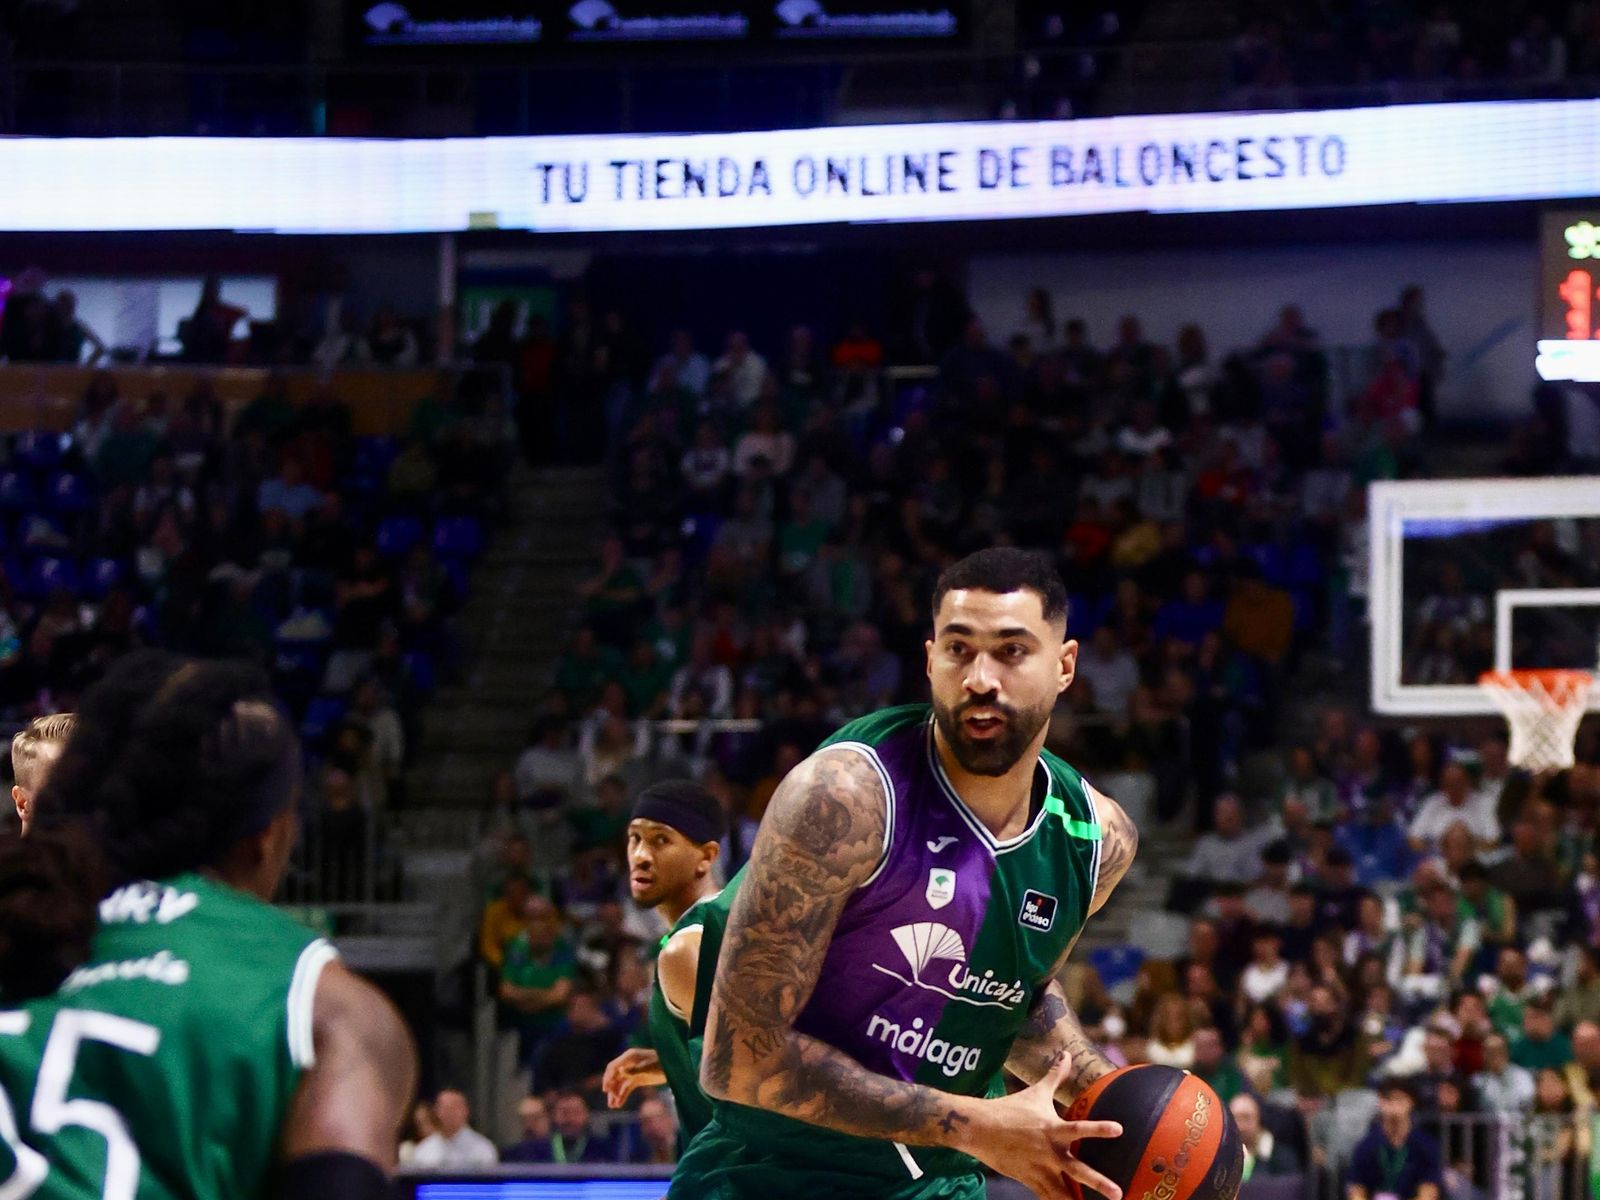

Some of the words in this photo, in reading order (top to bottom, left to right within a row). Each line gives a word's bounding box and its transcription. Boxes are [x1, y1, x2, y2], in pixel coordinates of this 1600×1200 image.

[536, 160, 588, 203] TU
[609, 157, 772, 200] TIENDA
[793, 151, 957, 195] ONLINE
[978, 145, 1031, 189] DE
[1049, 134, 1346, 187] BALONCESTO
[948, 962, 1026, 1004] Unicaja
